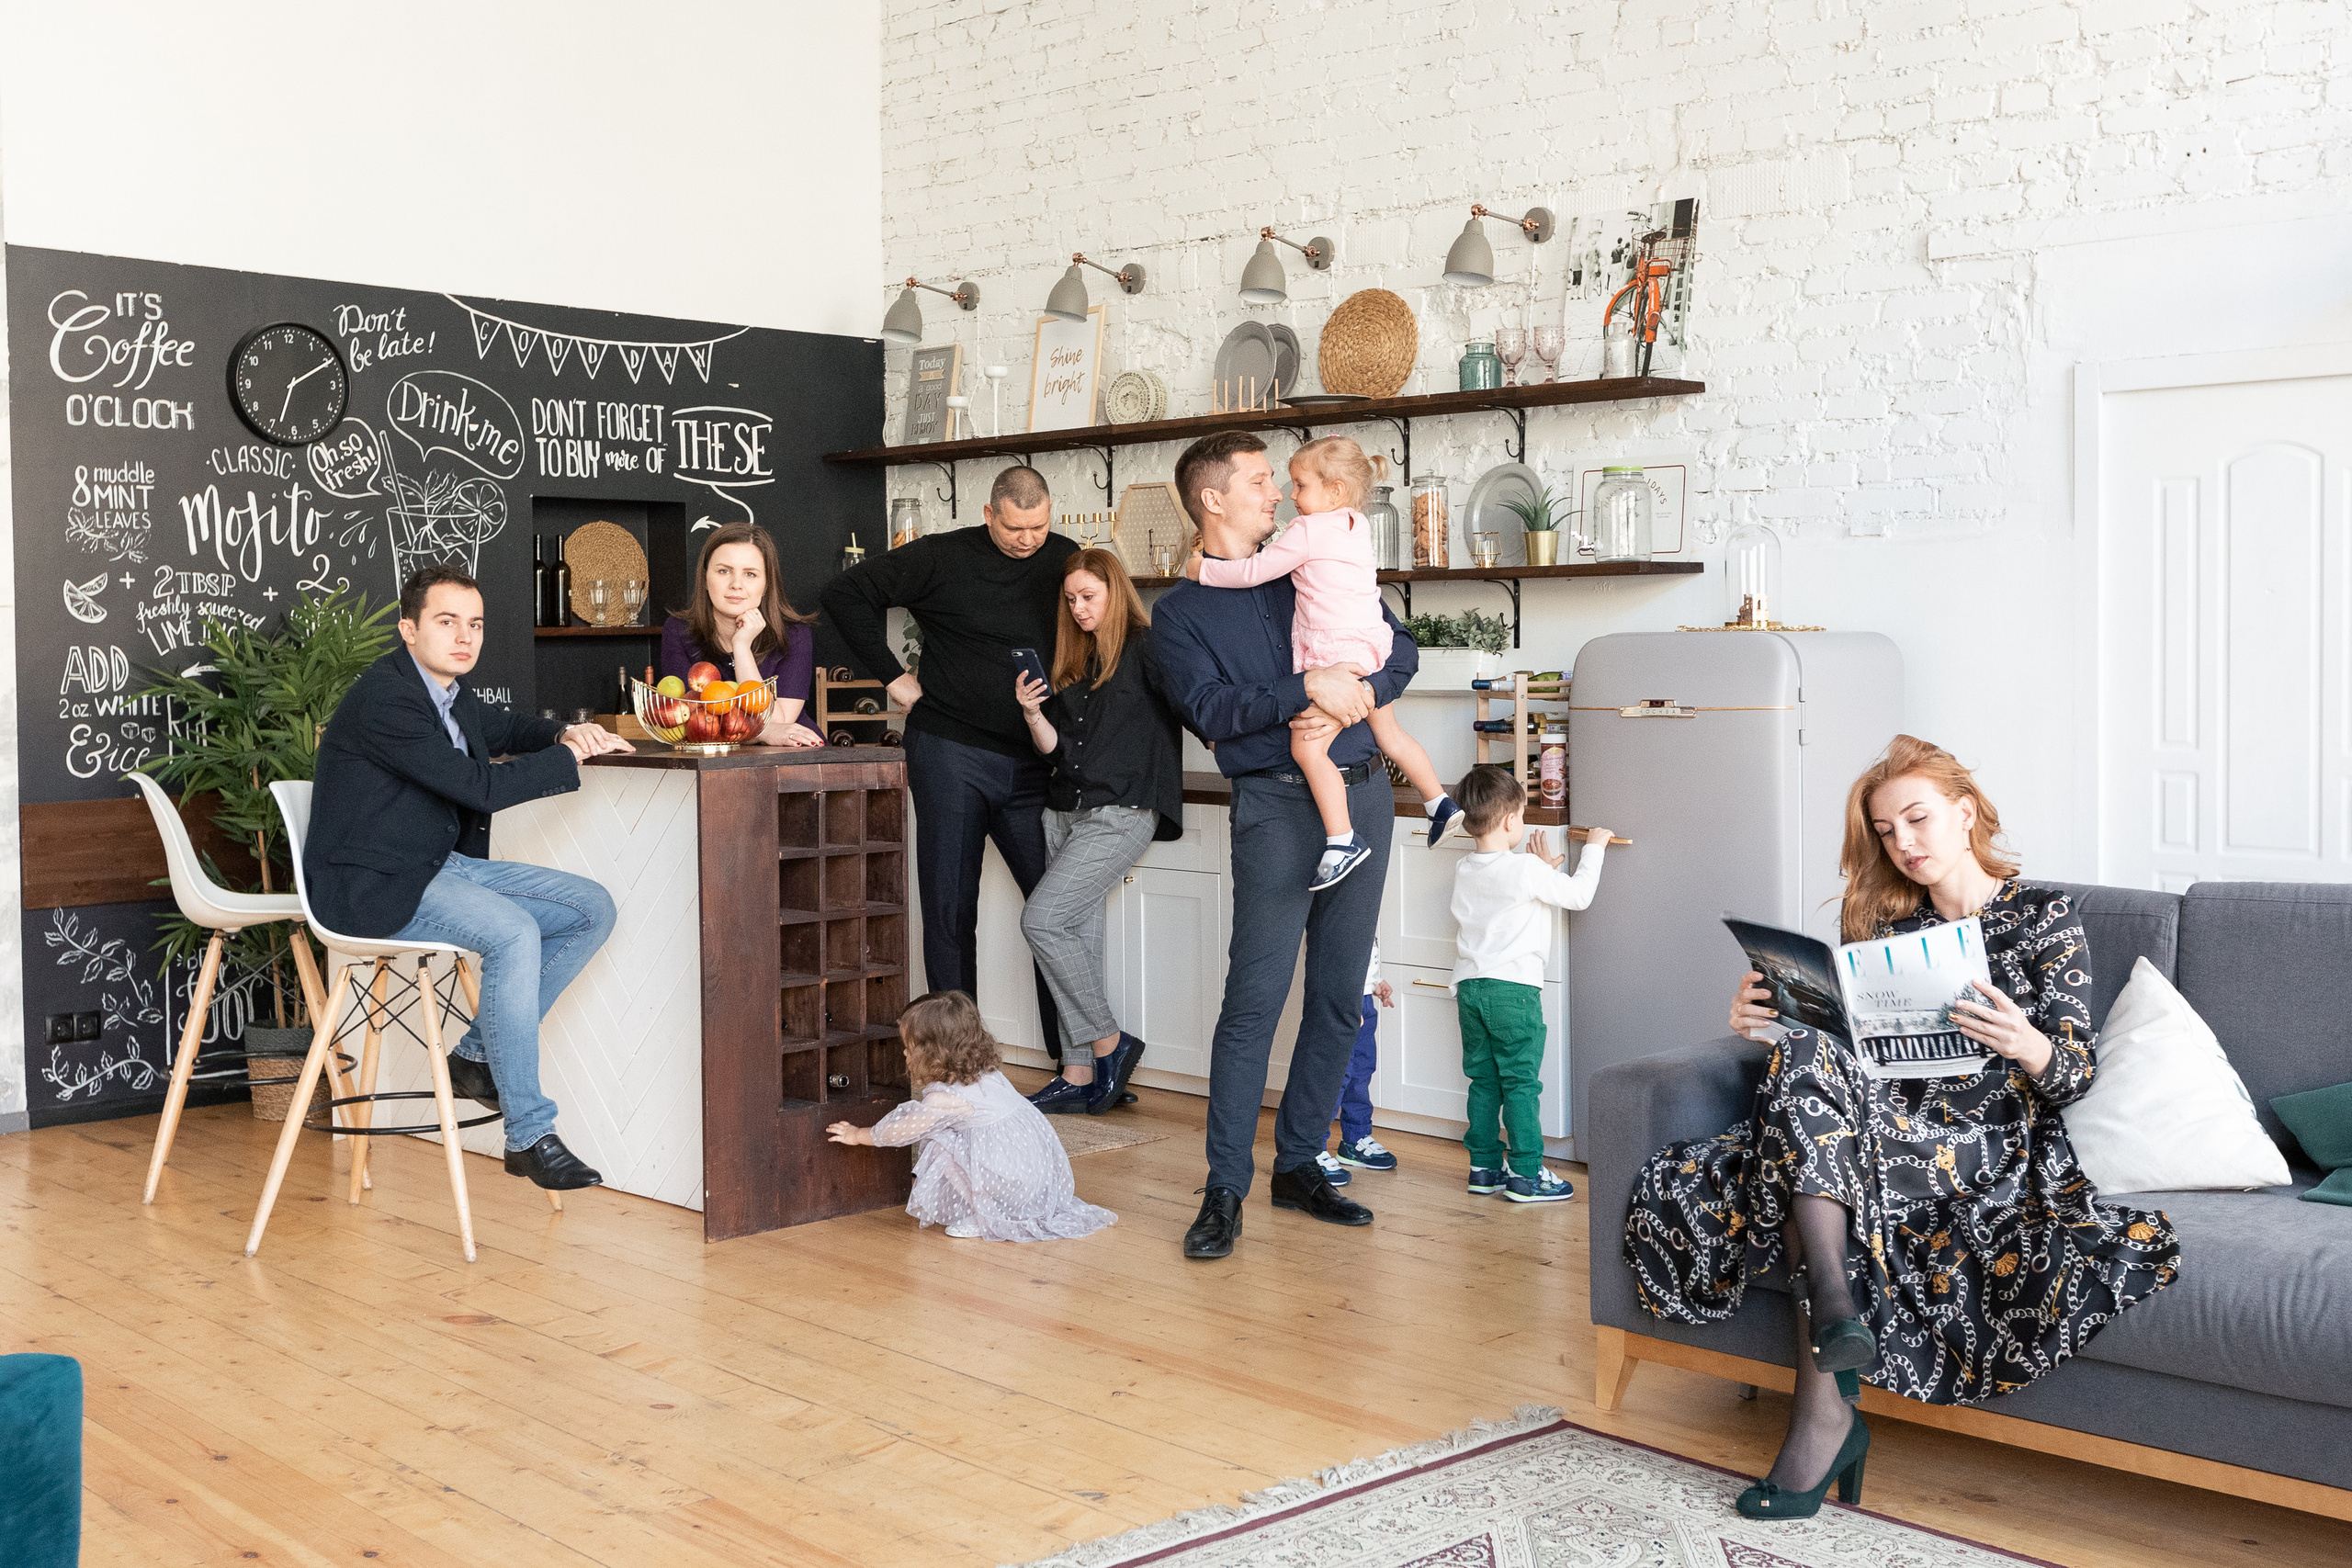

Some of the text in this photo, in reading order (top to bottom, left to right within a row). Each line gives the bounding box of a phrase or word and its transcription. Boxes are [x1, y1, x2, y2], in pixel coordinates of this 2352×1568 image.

[116, 292, 163, 321] IT'S
[333, 304, 406, 337] Don't
[48, 289, 196, 390] Coffee
[284, 333, 294, 344] 12
[249, 355, 259, 367] 10
[349, 332, 436, 373] be late!
[629, 347, 707, 369] DAY
[919, 355, 946, 371] Today
[1050, 344, 1085, 369] Shine
[244, 378, 252, 389] 9
[329, 380, 336, 390] 3
[925, 381, 943, 393] good
[1044, 370, 1086, 405] bright
[253, 400, 259, 412] 8
[327, 401, 334, 412] 4
[914, 392, 942, 411] DAY
[269, 418, 276, 429] 7
[312, 418, 319, 429] 5
[532, 398, 664, 444] DON'T FORGET
[910, 421, 938, 435] ENJOY
[918, 412, 936, 423] JUST
[291, 425, 298, 435] 6
[536, 437, 667, 479] TO BUY more OF
[672, 419, 774, 476] THESE
[211, 445, 293, 479] CLASSIC
[324, 445, 379, 491] fresh!
[72, 461, 155, 508] 8 muddle
[94, 485, 155, 510] MINT
[95, 511, 153, 531] LEAVES
[178, 481, 334, 582] Mojito
[153, 565, 175, 599] 2
[296, 553, 350, 594] 2
[136, 594, 192, 634] freshly
[147, 620, 195, 656] LIME
[60, 645, 130, 695] ADD
[59, 699, 70, 719] 2
[94, 695, 163, 717] WHITE
[472, 687, 513, 705] HBALL
[1847, 924, 1975, 978] ELLE
[1857, 989, 1898, 1002] SNOW
[1875, 998, 1913, 1008] TIME
